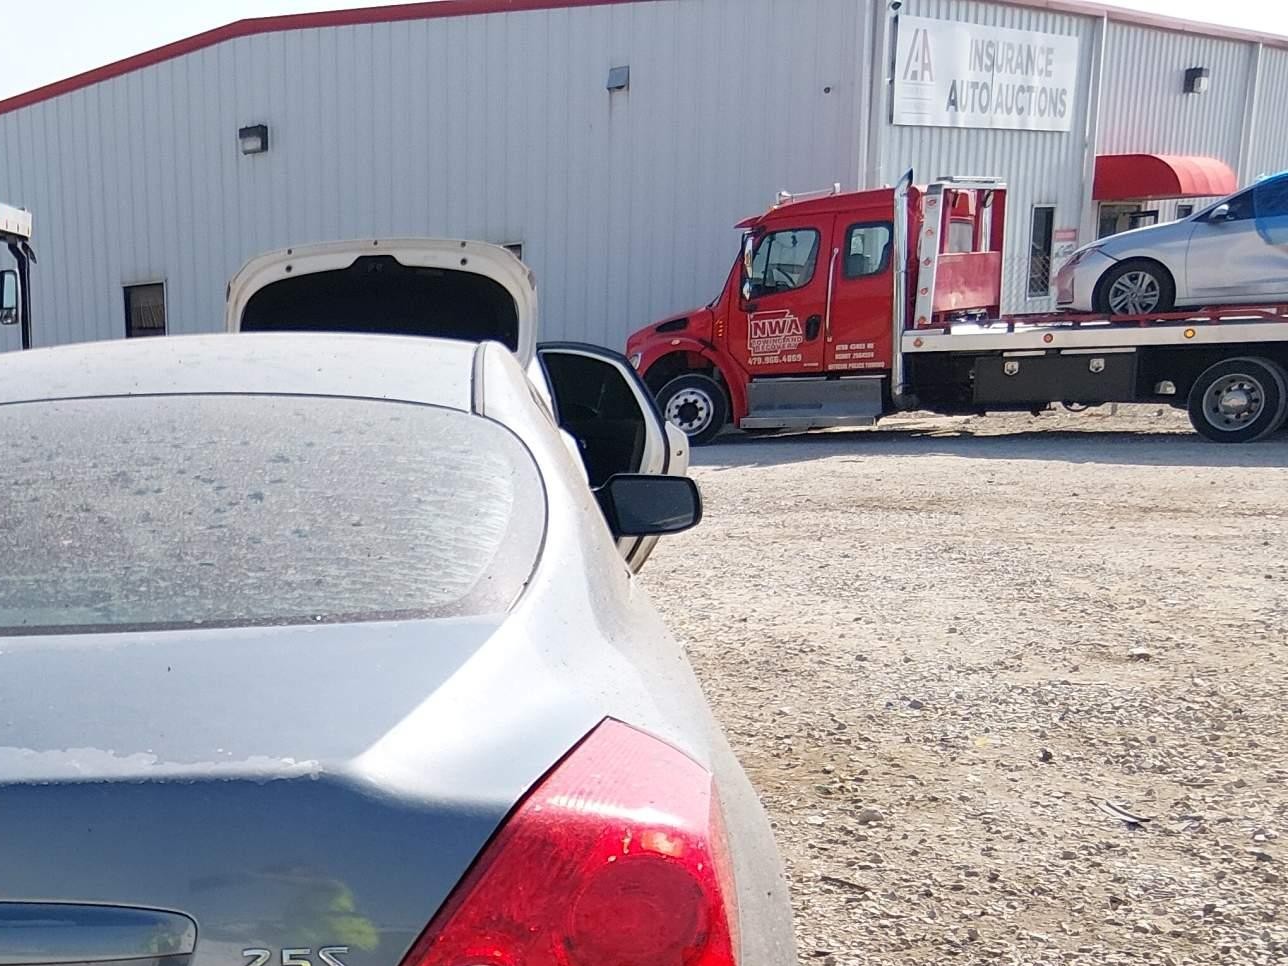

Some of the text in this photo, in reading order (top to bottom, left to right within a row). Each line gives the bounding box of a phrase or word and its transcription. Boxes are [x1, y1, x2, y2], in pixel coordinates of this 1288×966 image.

[968, 38, 1055, 78] INSURANCE
[945, 79, 1068, 119] AUTO AUCTIONS
[751, 317, 803, 338] NWA
